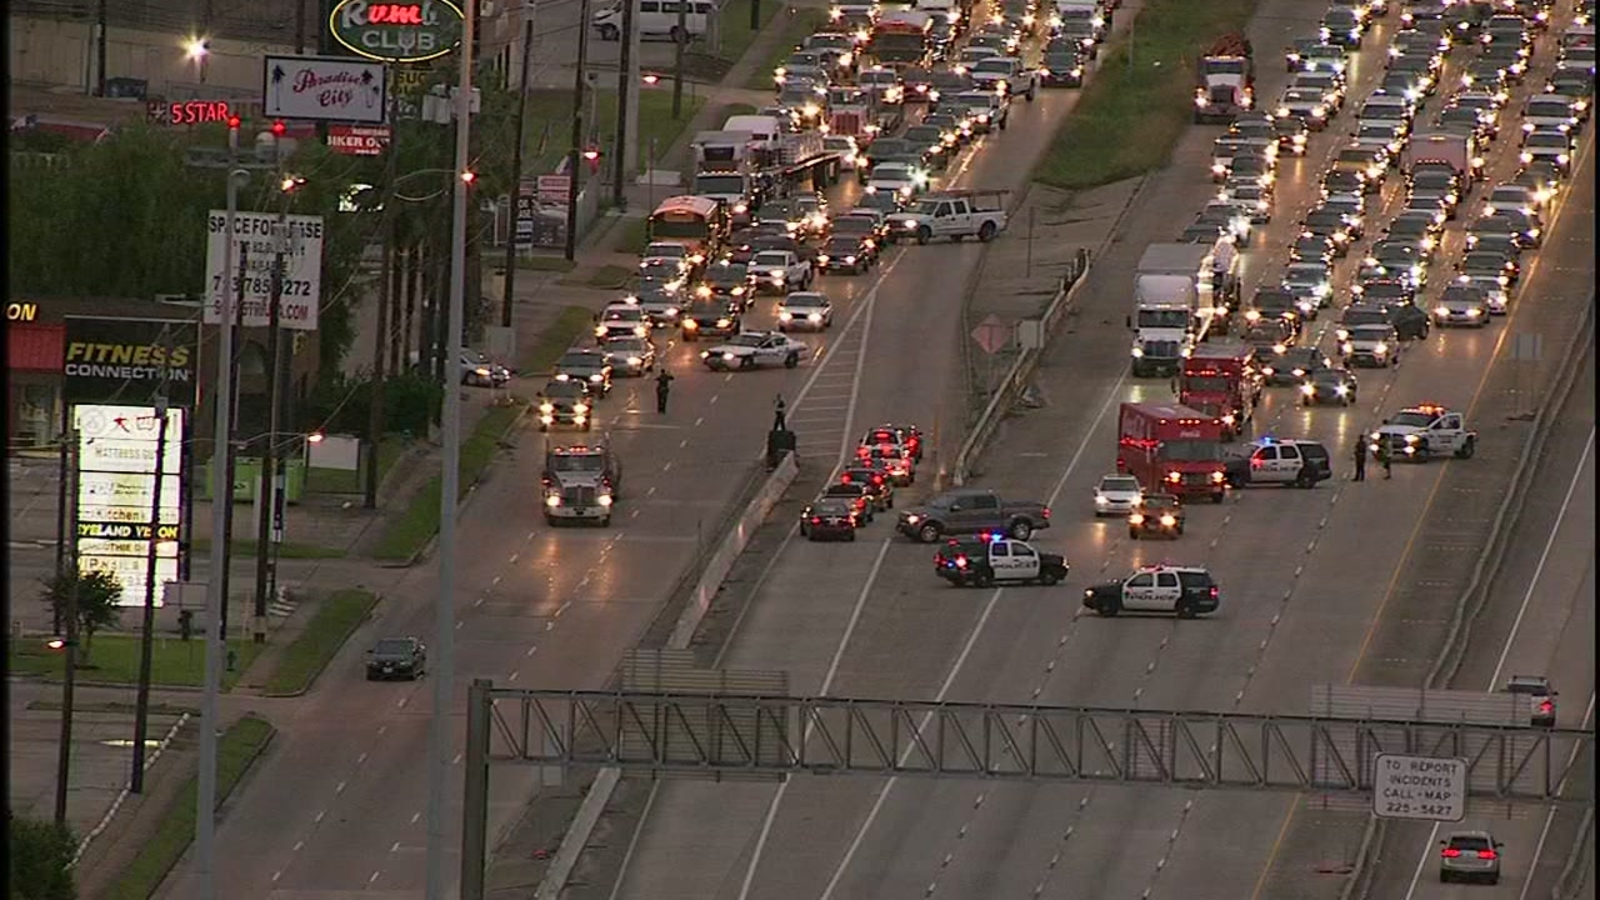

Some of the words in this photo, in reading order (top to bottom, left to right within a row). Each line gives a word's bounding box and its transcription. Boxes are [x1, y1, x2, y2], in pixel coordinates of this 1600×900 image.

[361, 30, 436, 52] CLUB
[293, 69, 362, 94] Paradise
[319, 88, 352, 108] City
[172, 103, 182, 124] 5
[185, 102, 229, 122] STAR
[209, 215, 250, 235] SPCE
[213, 275, 240, 293] 73
[278, 279, 312, 297] 272
[7, 303, 37, 321] ON
[67, 342, 190, 367] FITNESS
[65, 364, 188, 381] CONNECTN
[1386, 760, 1401, 770] TO
[1410, 761, 1458, 775] REPORT
[1389, 774, 1452, 788] INCIDENTS
